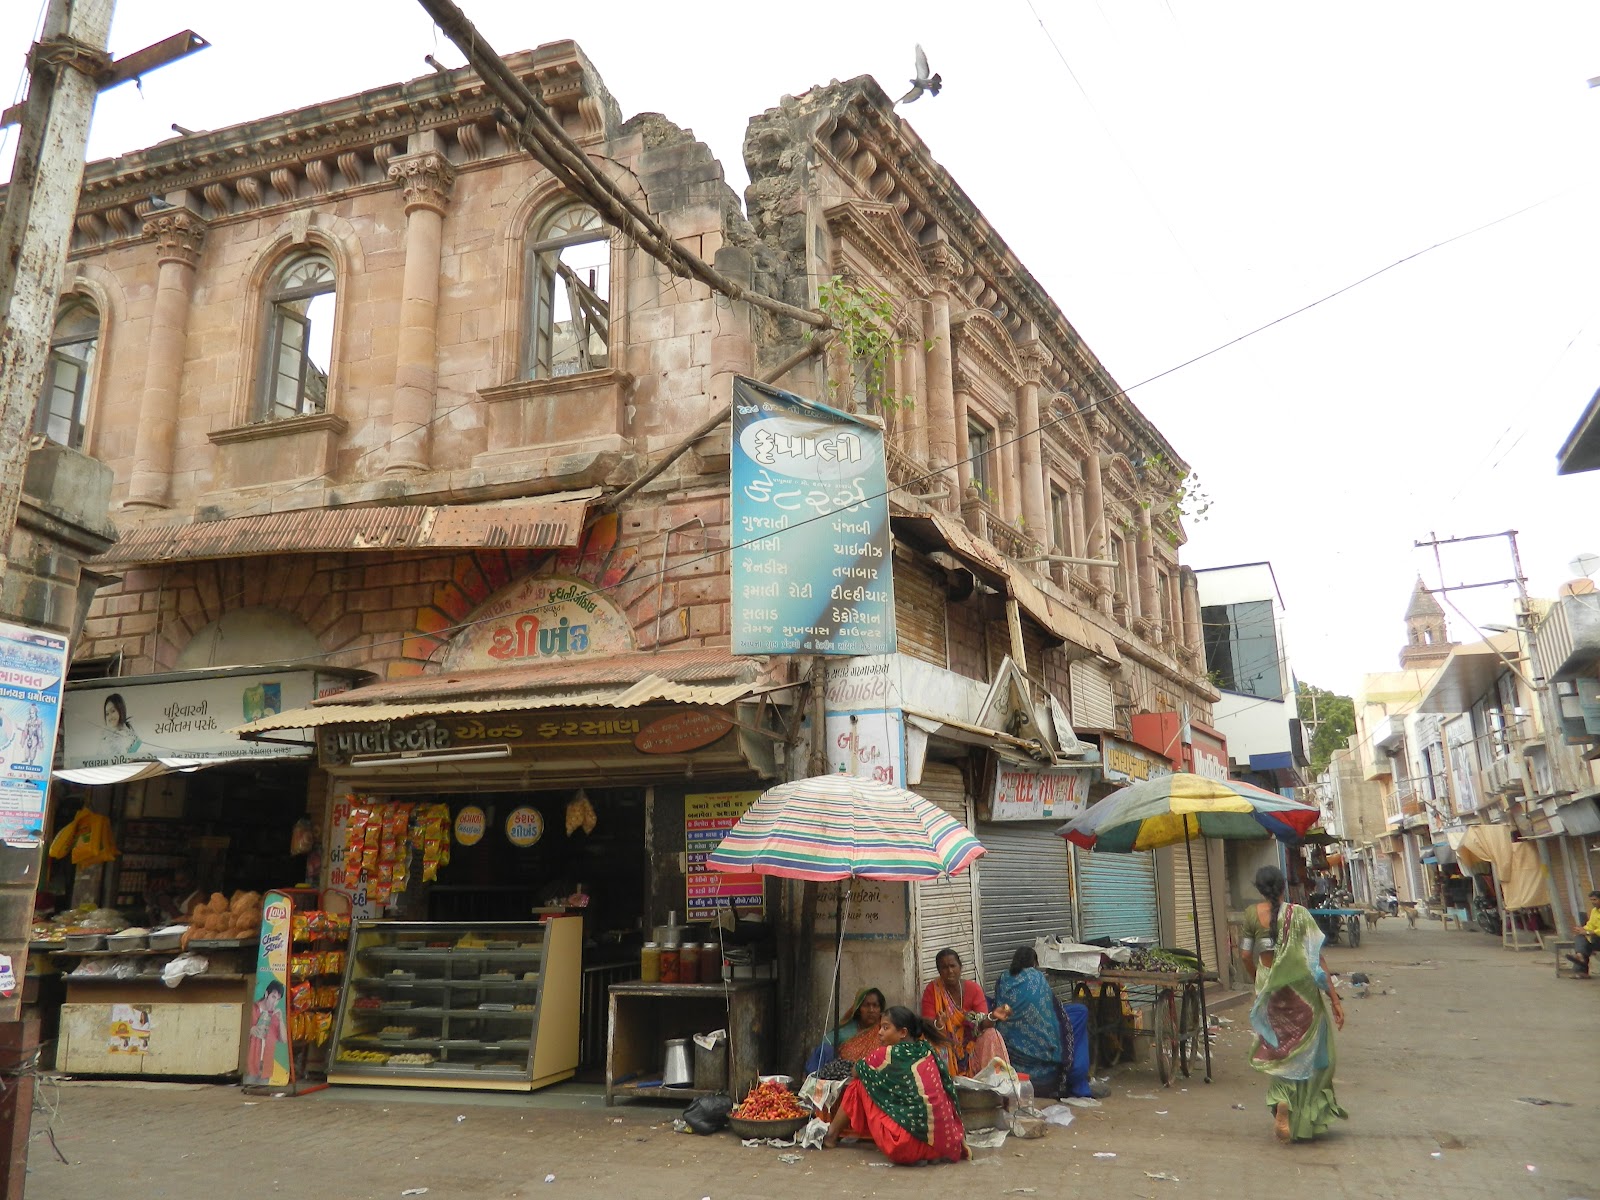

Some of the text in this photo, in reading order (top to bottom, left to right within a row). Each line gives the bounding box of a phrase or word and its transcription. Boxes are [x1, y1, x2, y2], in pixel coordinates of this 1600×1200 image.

[742, 515, 788, 532] ગુજરાતી
[832, 519, 870, 535] પંજાબી
[742, 537, 780, 551] મદ્રાસી
[833, 543, 883, 558] ચાઇનીઝ
[832, 566, 878, 580] તવાબાર
[742, 582, 812, 599] રૂમાલી રોટી
[742, 608, 779, 621] સલાડ
[832, 607, 881, 624] ડેકોરેશન
[487, 615, 590, 661] શીખંડ
[742, 623, 881, 638] તેમજ મુખવાસ કાઉન્ટર
[164, 700, 208, 718] પરિવારની
[194, 716, 218, 732] પસંદ
[455, 720, 523, 739] એન્ડ
[537, 719, 640, 739] ફરસાણ
[511, 824, 537, 837] શીખંડ
